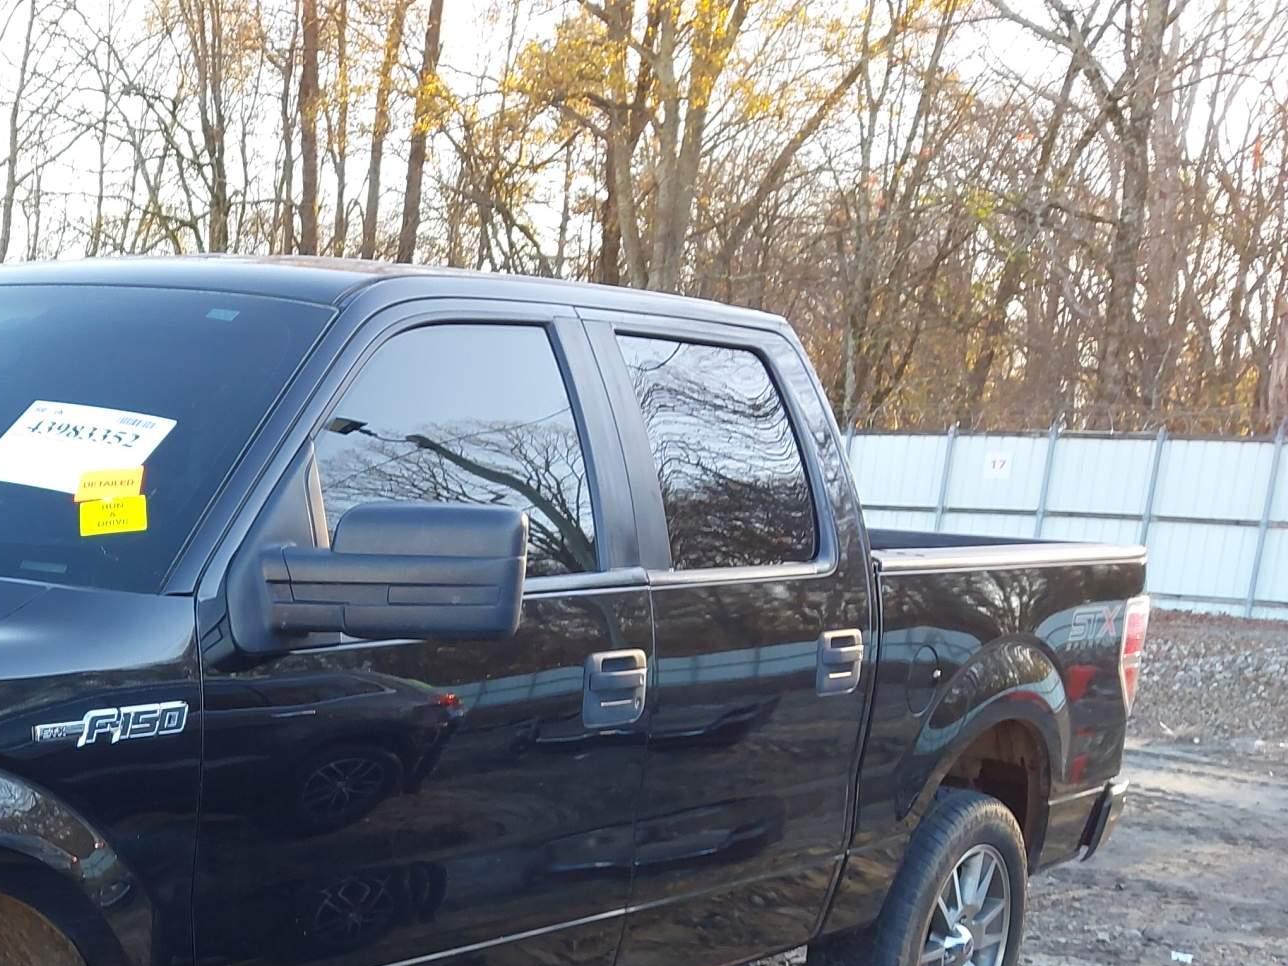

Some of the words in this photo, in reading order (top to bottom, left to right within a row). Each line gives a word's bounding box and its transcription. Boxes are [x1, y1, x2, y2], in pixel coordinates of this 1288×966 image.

[27, 420, 140, 448] 43983352
[992, 459, 1007, 470] 17
[83, 480, 135, 488] DETAILED
[97, 519, 129, 527] DRIVE
[1068, 605, 1122, 641] STX
[77, 700, 189, 748] F-150
